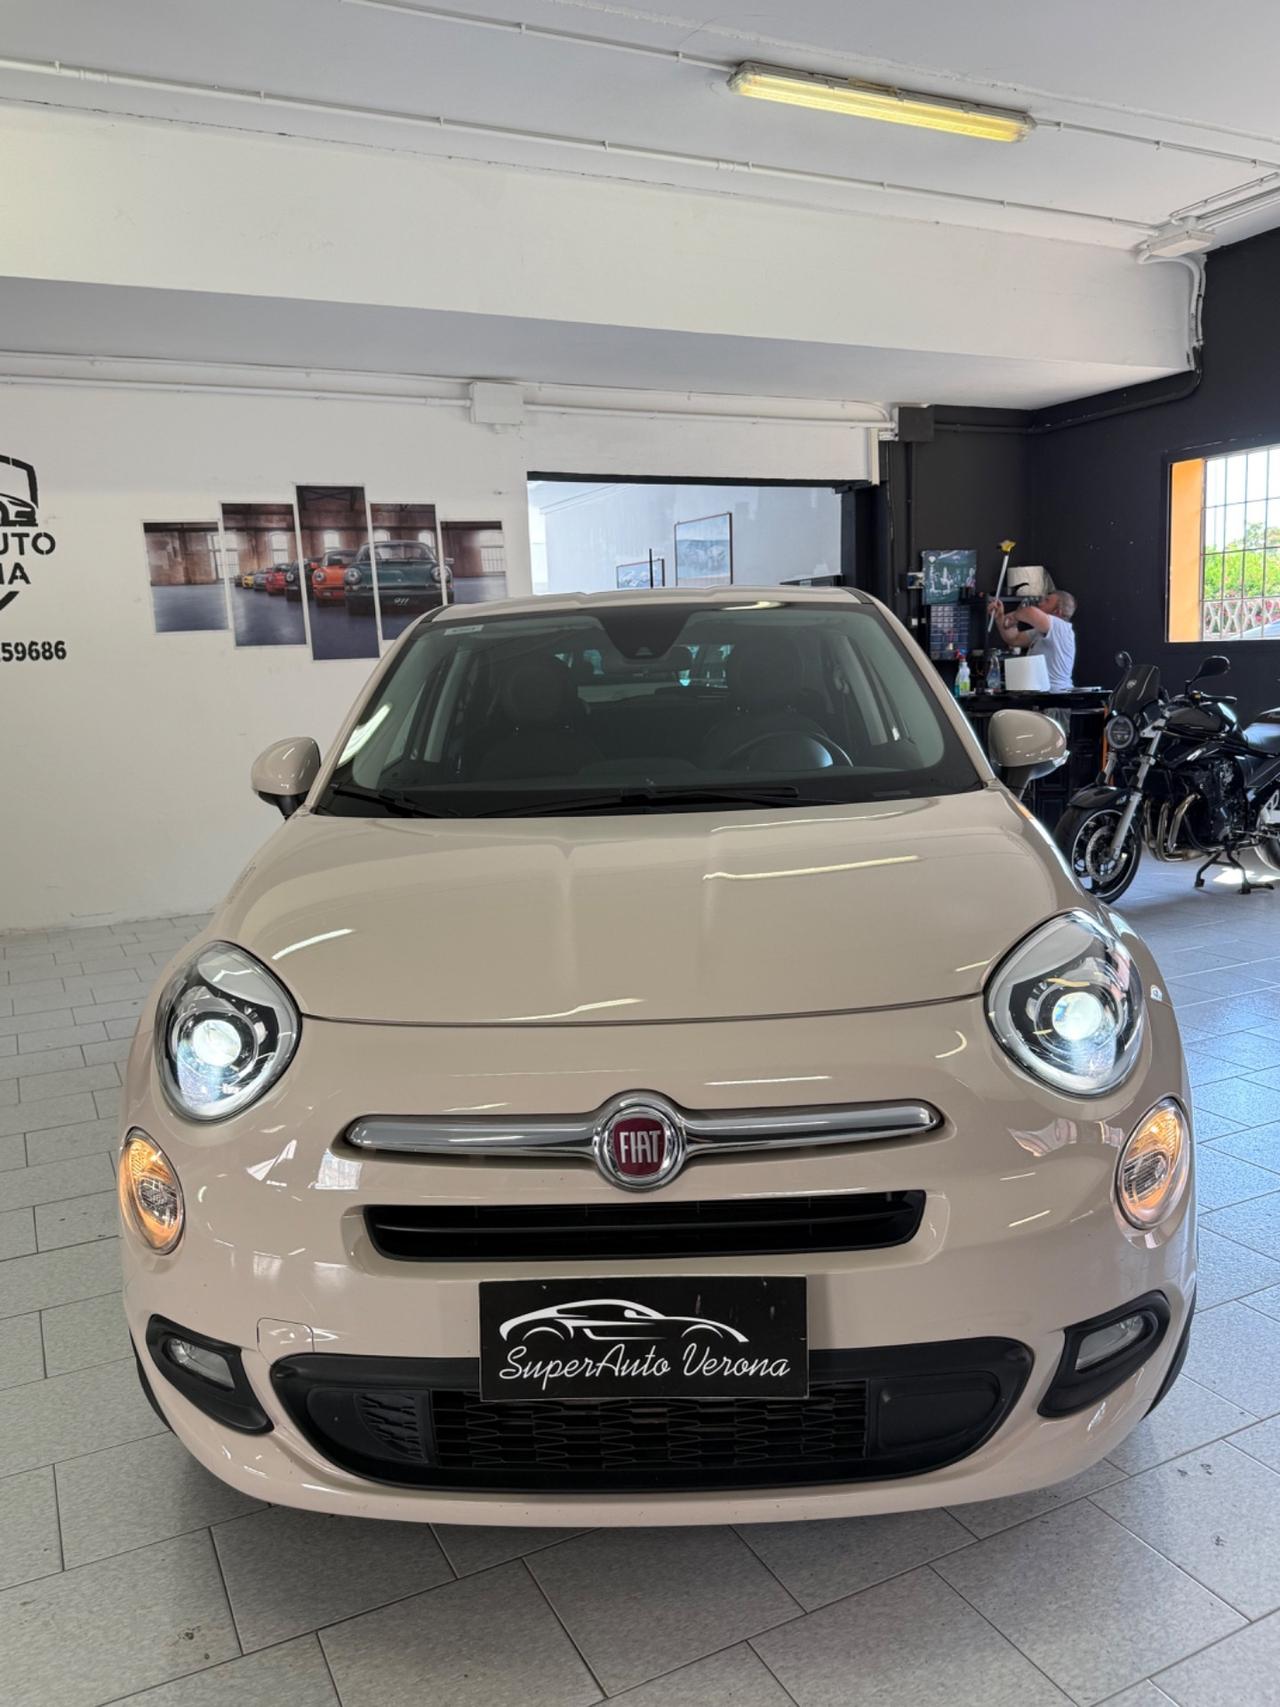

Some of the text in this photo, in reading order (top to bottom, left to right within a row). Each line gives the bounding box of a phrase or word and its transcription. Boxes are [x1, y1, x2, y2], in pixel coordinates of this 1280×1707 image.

[619, 1130, 661, 1163] FIAT
[499, 1343, 790, 1391] SuperAuto Verona
